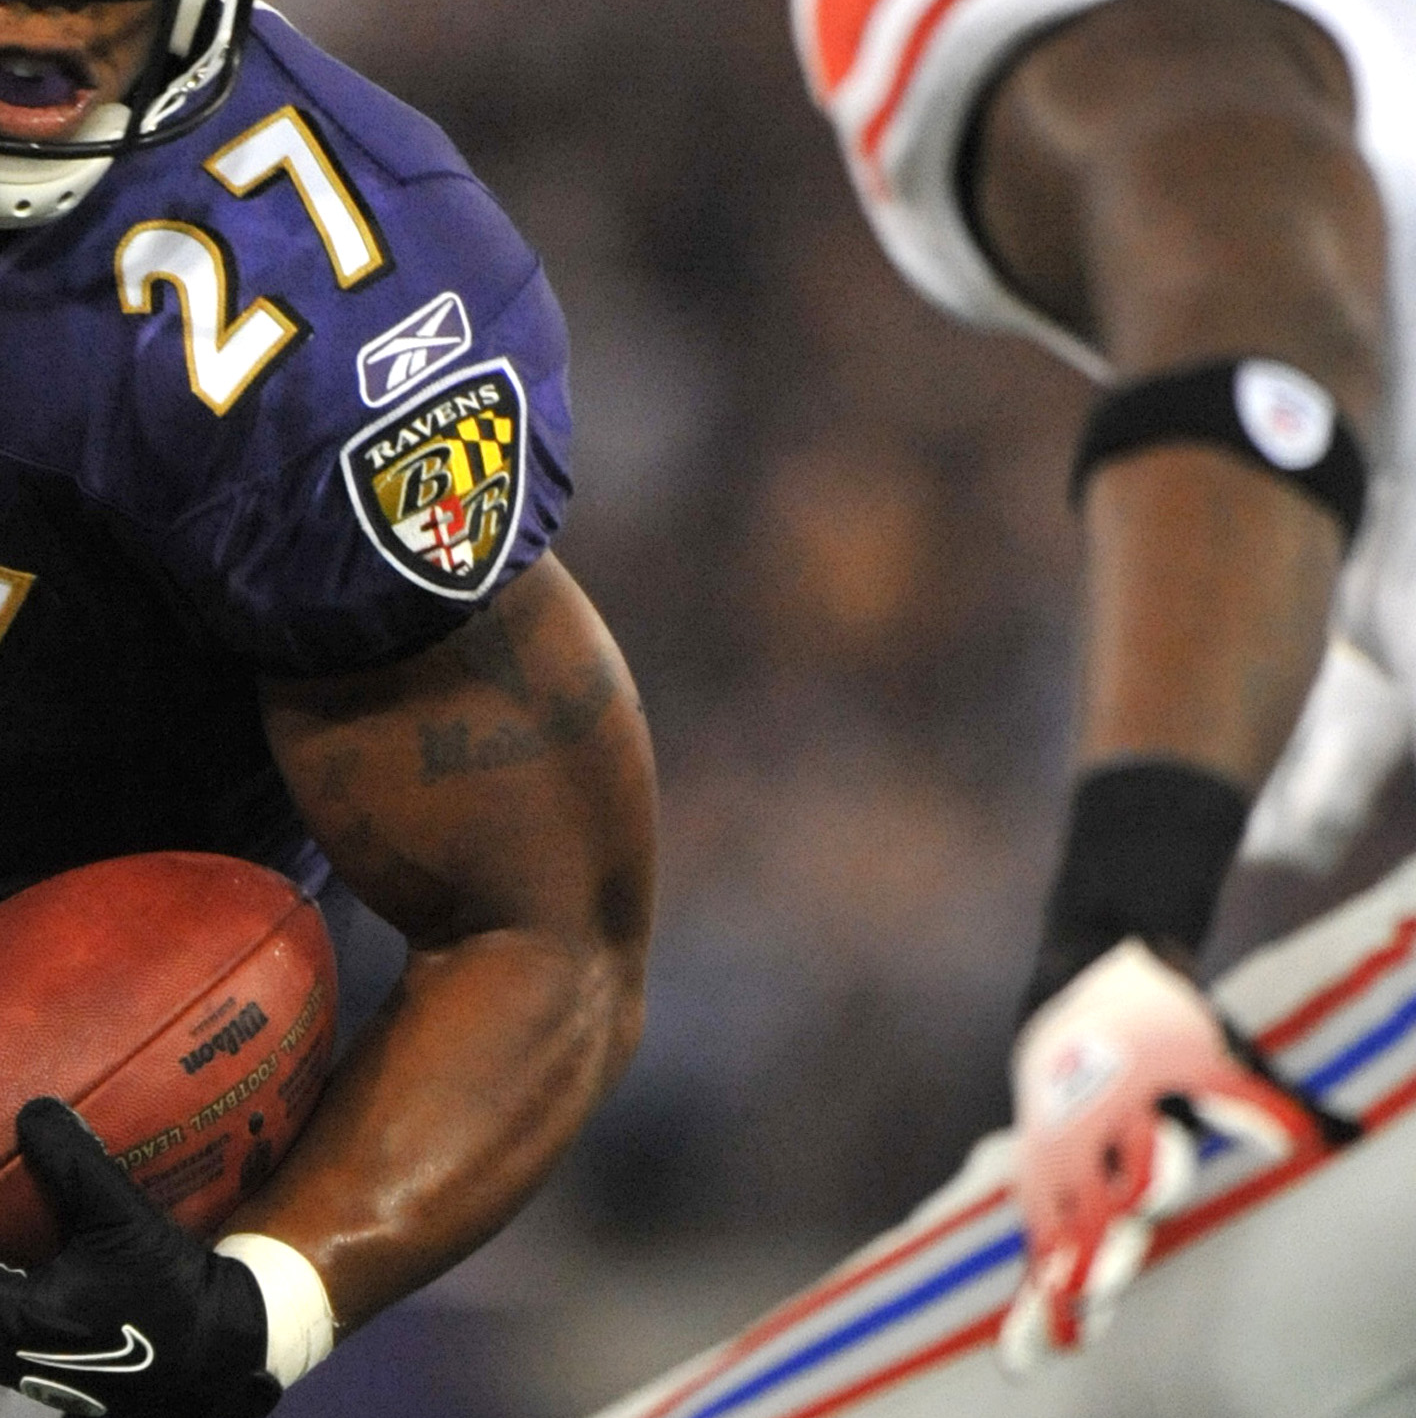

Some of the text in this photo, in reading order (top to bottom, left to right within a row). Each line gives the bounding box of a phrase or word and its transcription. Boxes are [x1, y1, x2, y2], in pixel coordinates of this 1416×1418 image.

[115, 105, 383, 417] 27
[364, 383, 501, 469] RAVENS
[179, 1000, 269, 1075] Wilson
[189, 1053, 280, 1131] FOOTBALL
